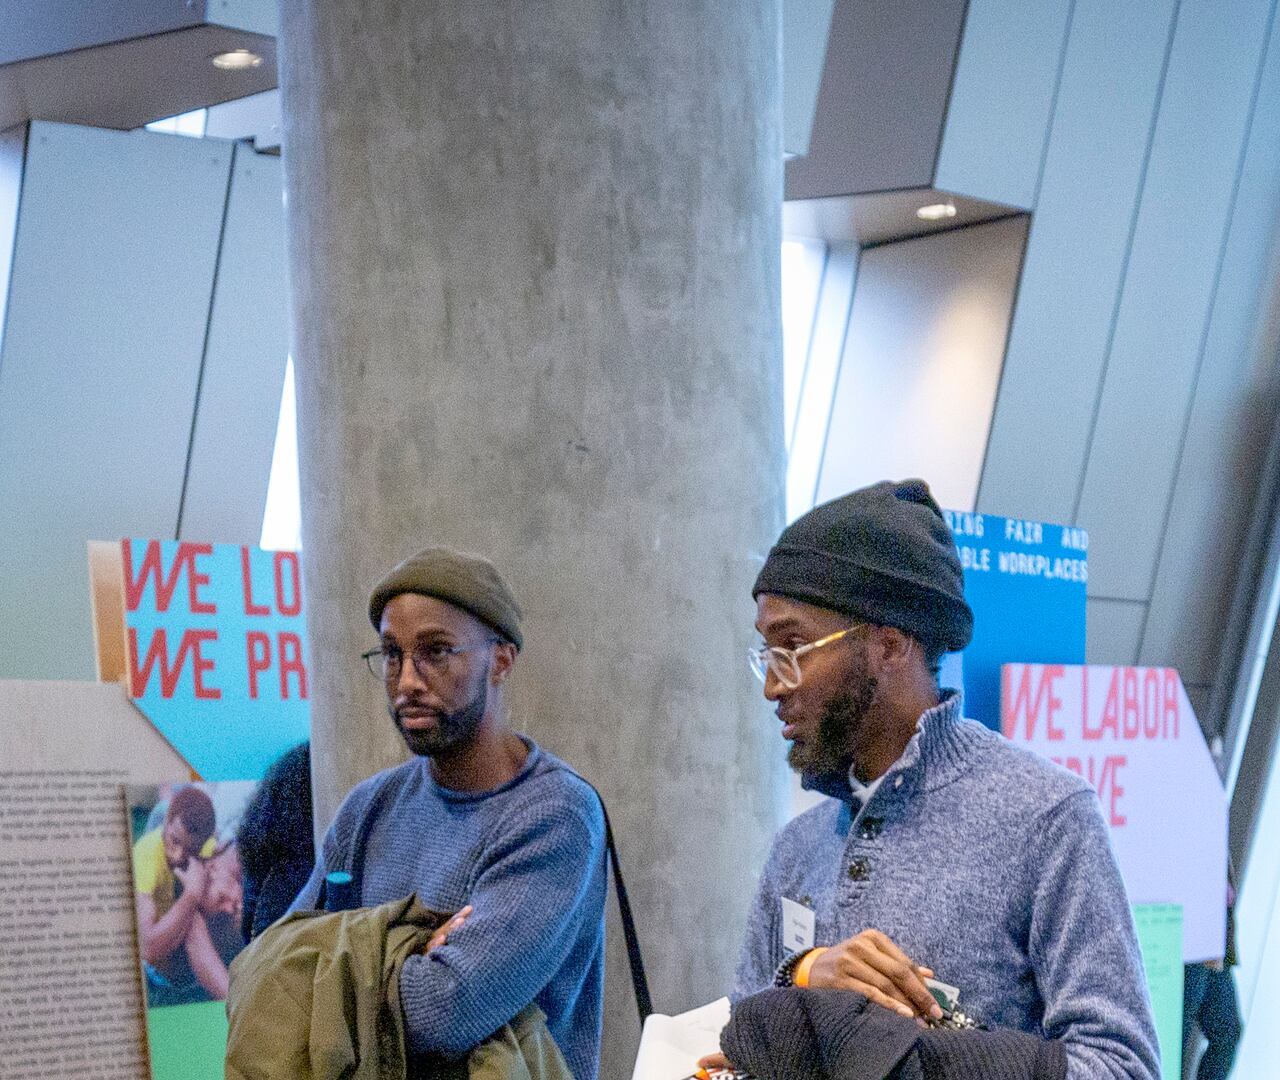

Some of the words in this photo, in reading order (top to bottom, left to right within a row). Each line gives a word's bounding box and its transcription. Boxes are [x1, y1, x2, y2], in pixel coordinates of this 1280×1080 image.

[999, 551, 1088, 582] WORKPLACES
[1006, 519, 1043, 544] FAIR
[1061, 527, 1089, 551] AND
[122, 538, 216, 614] WE
[128, 627, 221, 699] WE
[1001, 664, 1065, 740] WE
[1082, 666, 1179, 740] LABOR
